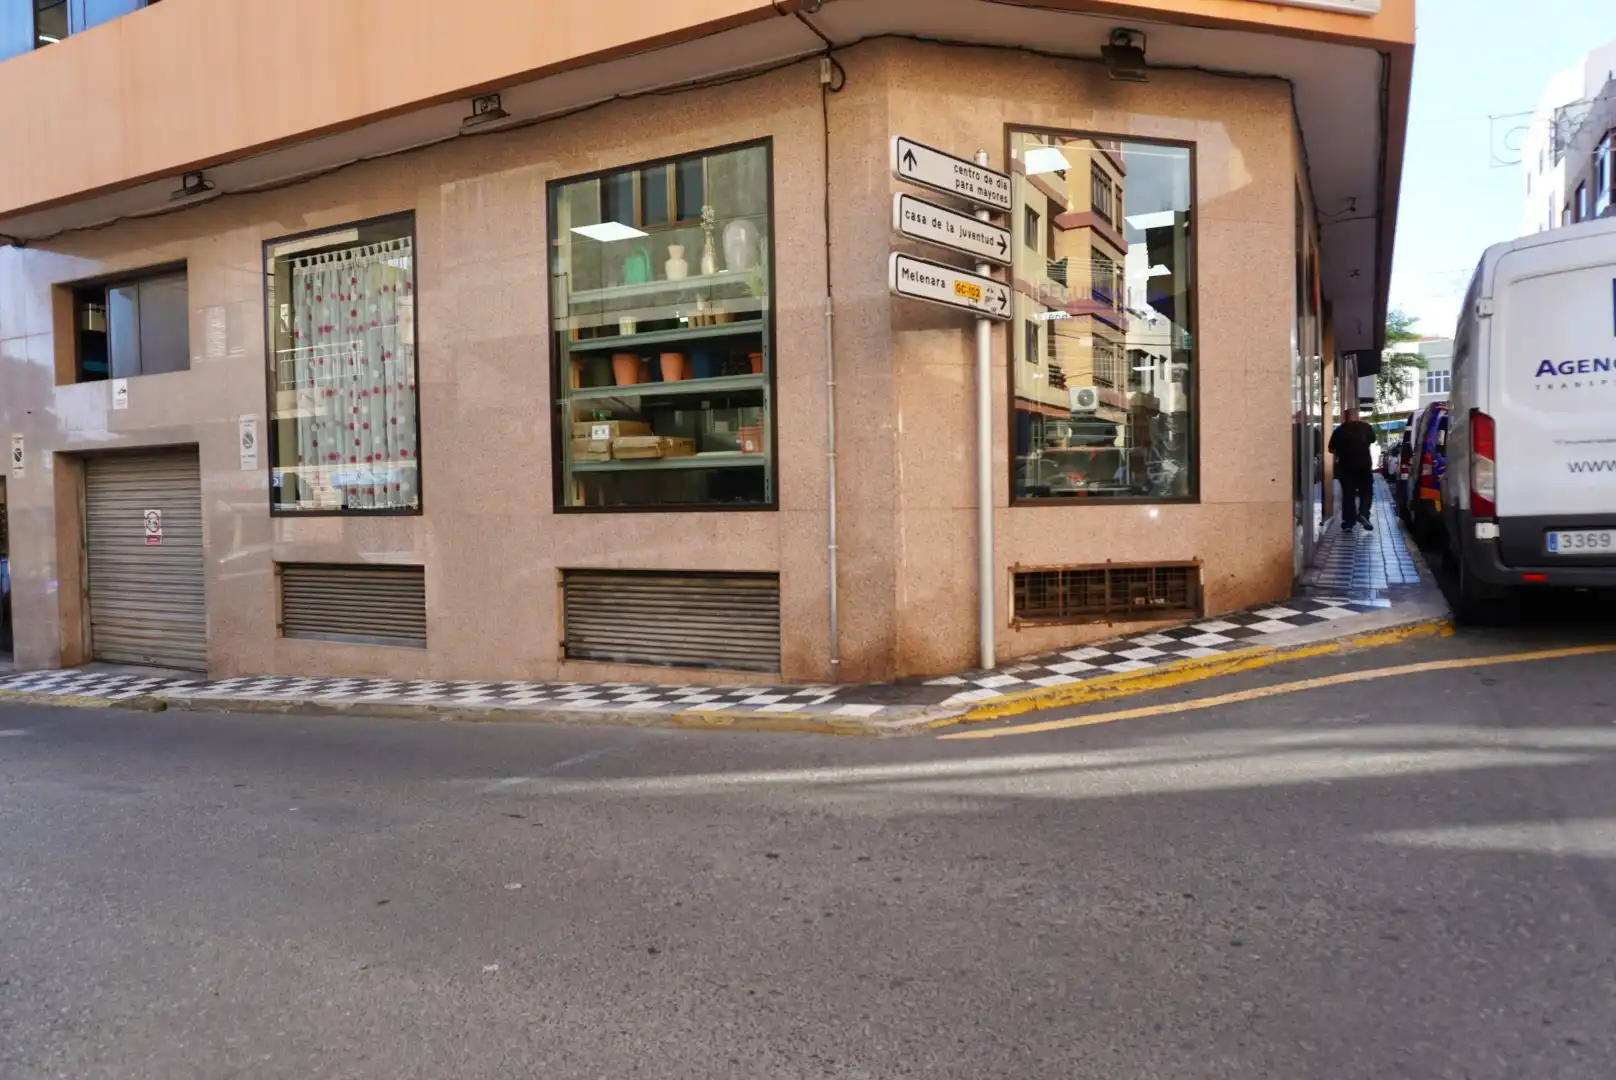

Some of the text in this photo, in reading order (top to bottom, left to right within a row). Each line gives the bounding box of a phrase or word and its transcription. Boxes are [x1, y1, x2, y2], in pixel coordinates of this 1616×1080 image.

[953, 164, 981, 181] centro
[983, 175, 993, 186] de
[955, 178, 1008, 204] para mayores
[904, 210, 995, 246] casa de la juventud
[901, 267, 946, 289] Melenara
[1535, 357, 1616, 378] AGEN
[1535, 379, 1616, 391] TRANSP
[1563, 532, 1611, 549] 3369
